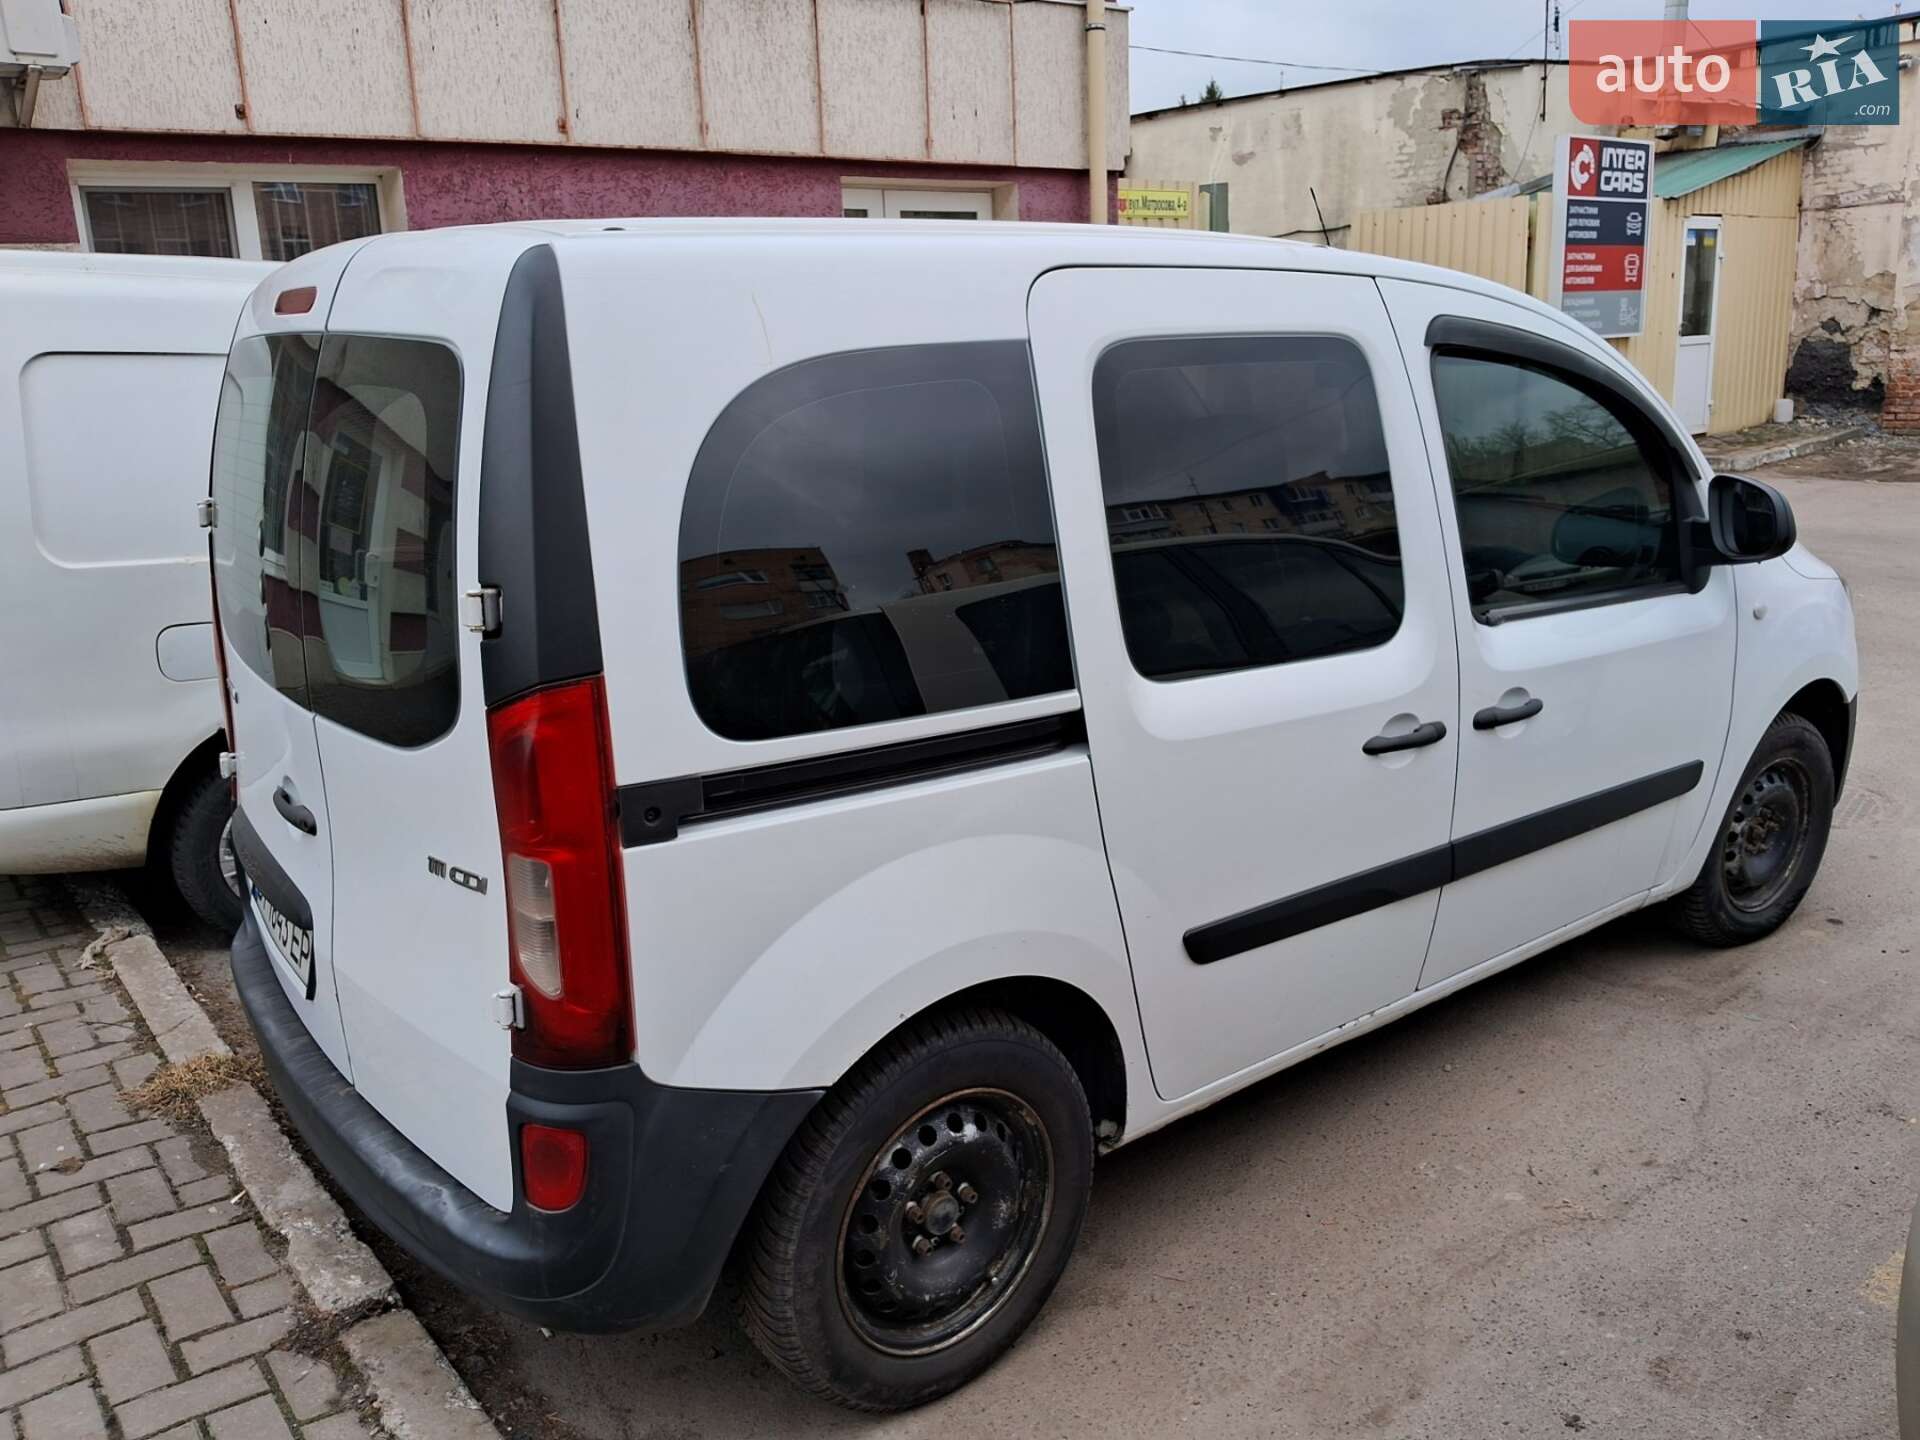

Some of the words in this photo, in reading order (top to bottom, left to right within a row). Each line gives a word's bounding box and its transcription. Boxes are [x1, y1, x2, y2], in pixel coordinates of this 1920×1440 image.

[1602, 146, 1646, 171] INTER
[1600, 170, 1645, 194] CARS
[449, 866, 489, 896] CDI
